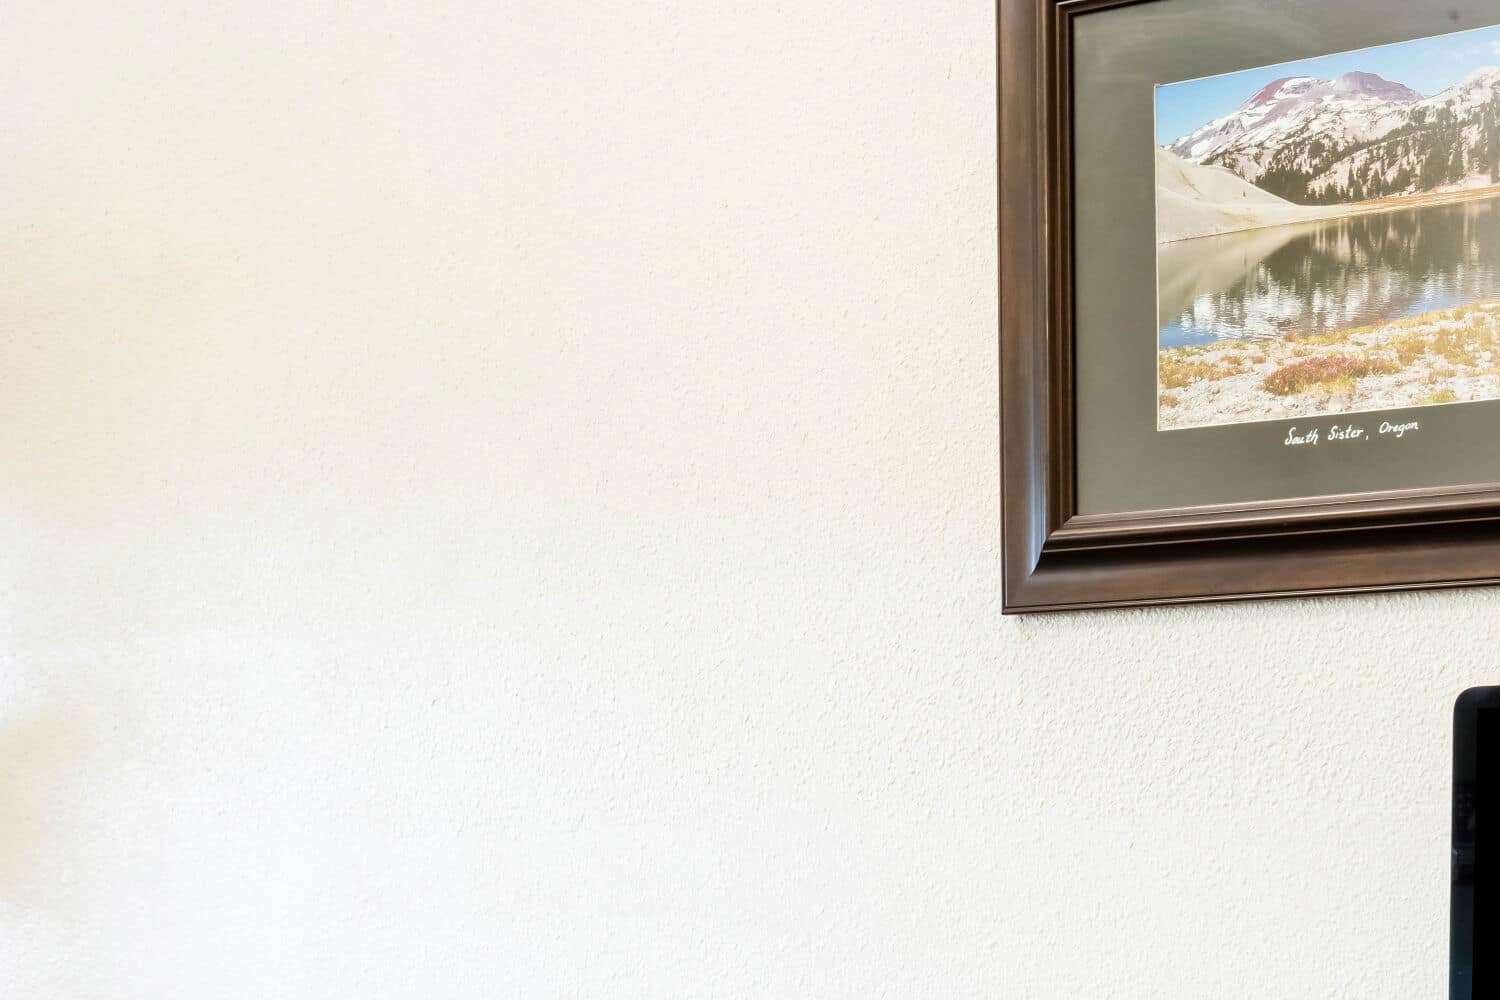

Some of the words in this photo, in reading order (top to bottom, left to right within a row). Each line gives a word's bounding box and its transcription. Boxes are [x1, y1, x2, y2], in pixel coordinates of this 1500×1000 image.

[1285, 427, 1319, 445] South
[1328, 425, 1369, 440] Sister,
[1379, 422, 1419, 437] Oregon
